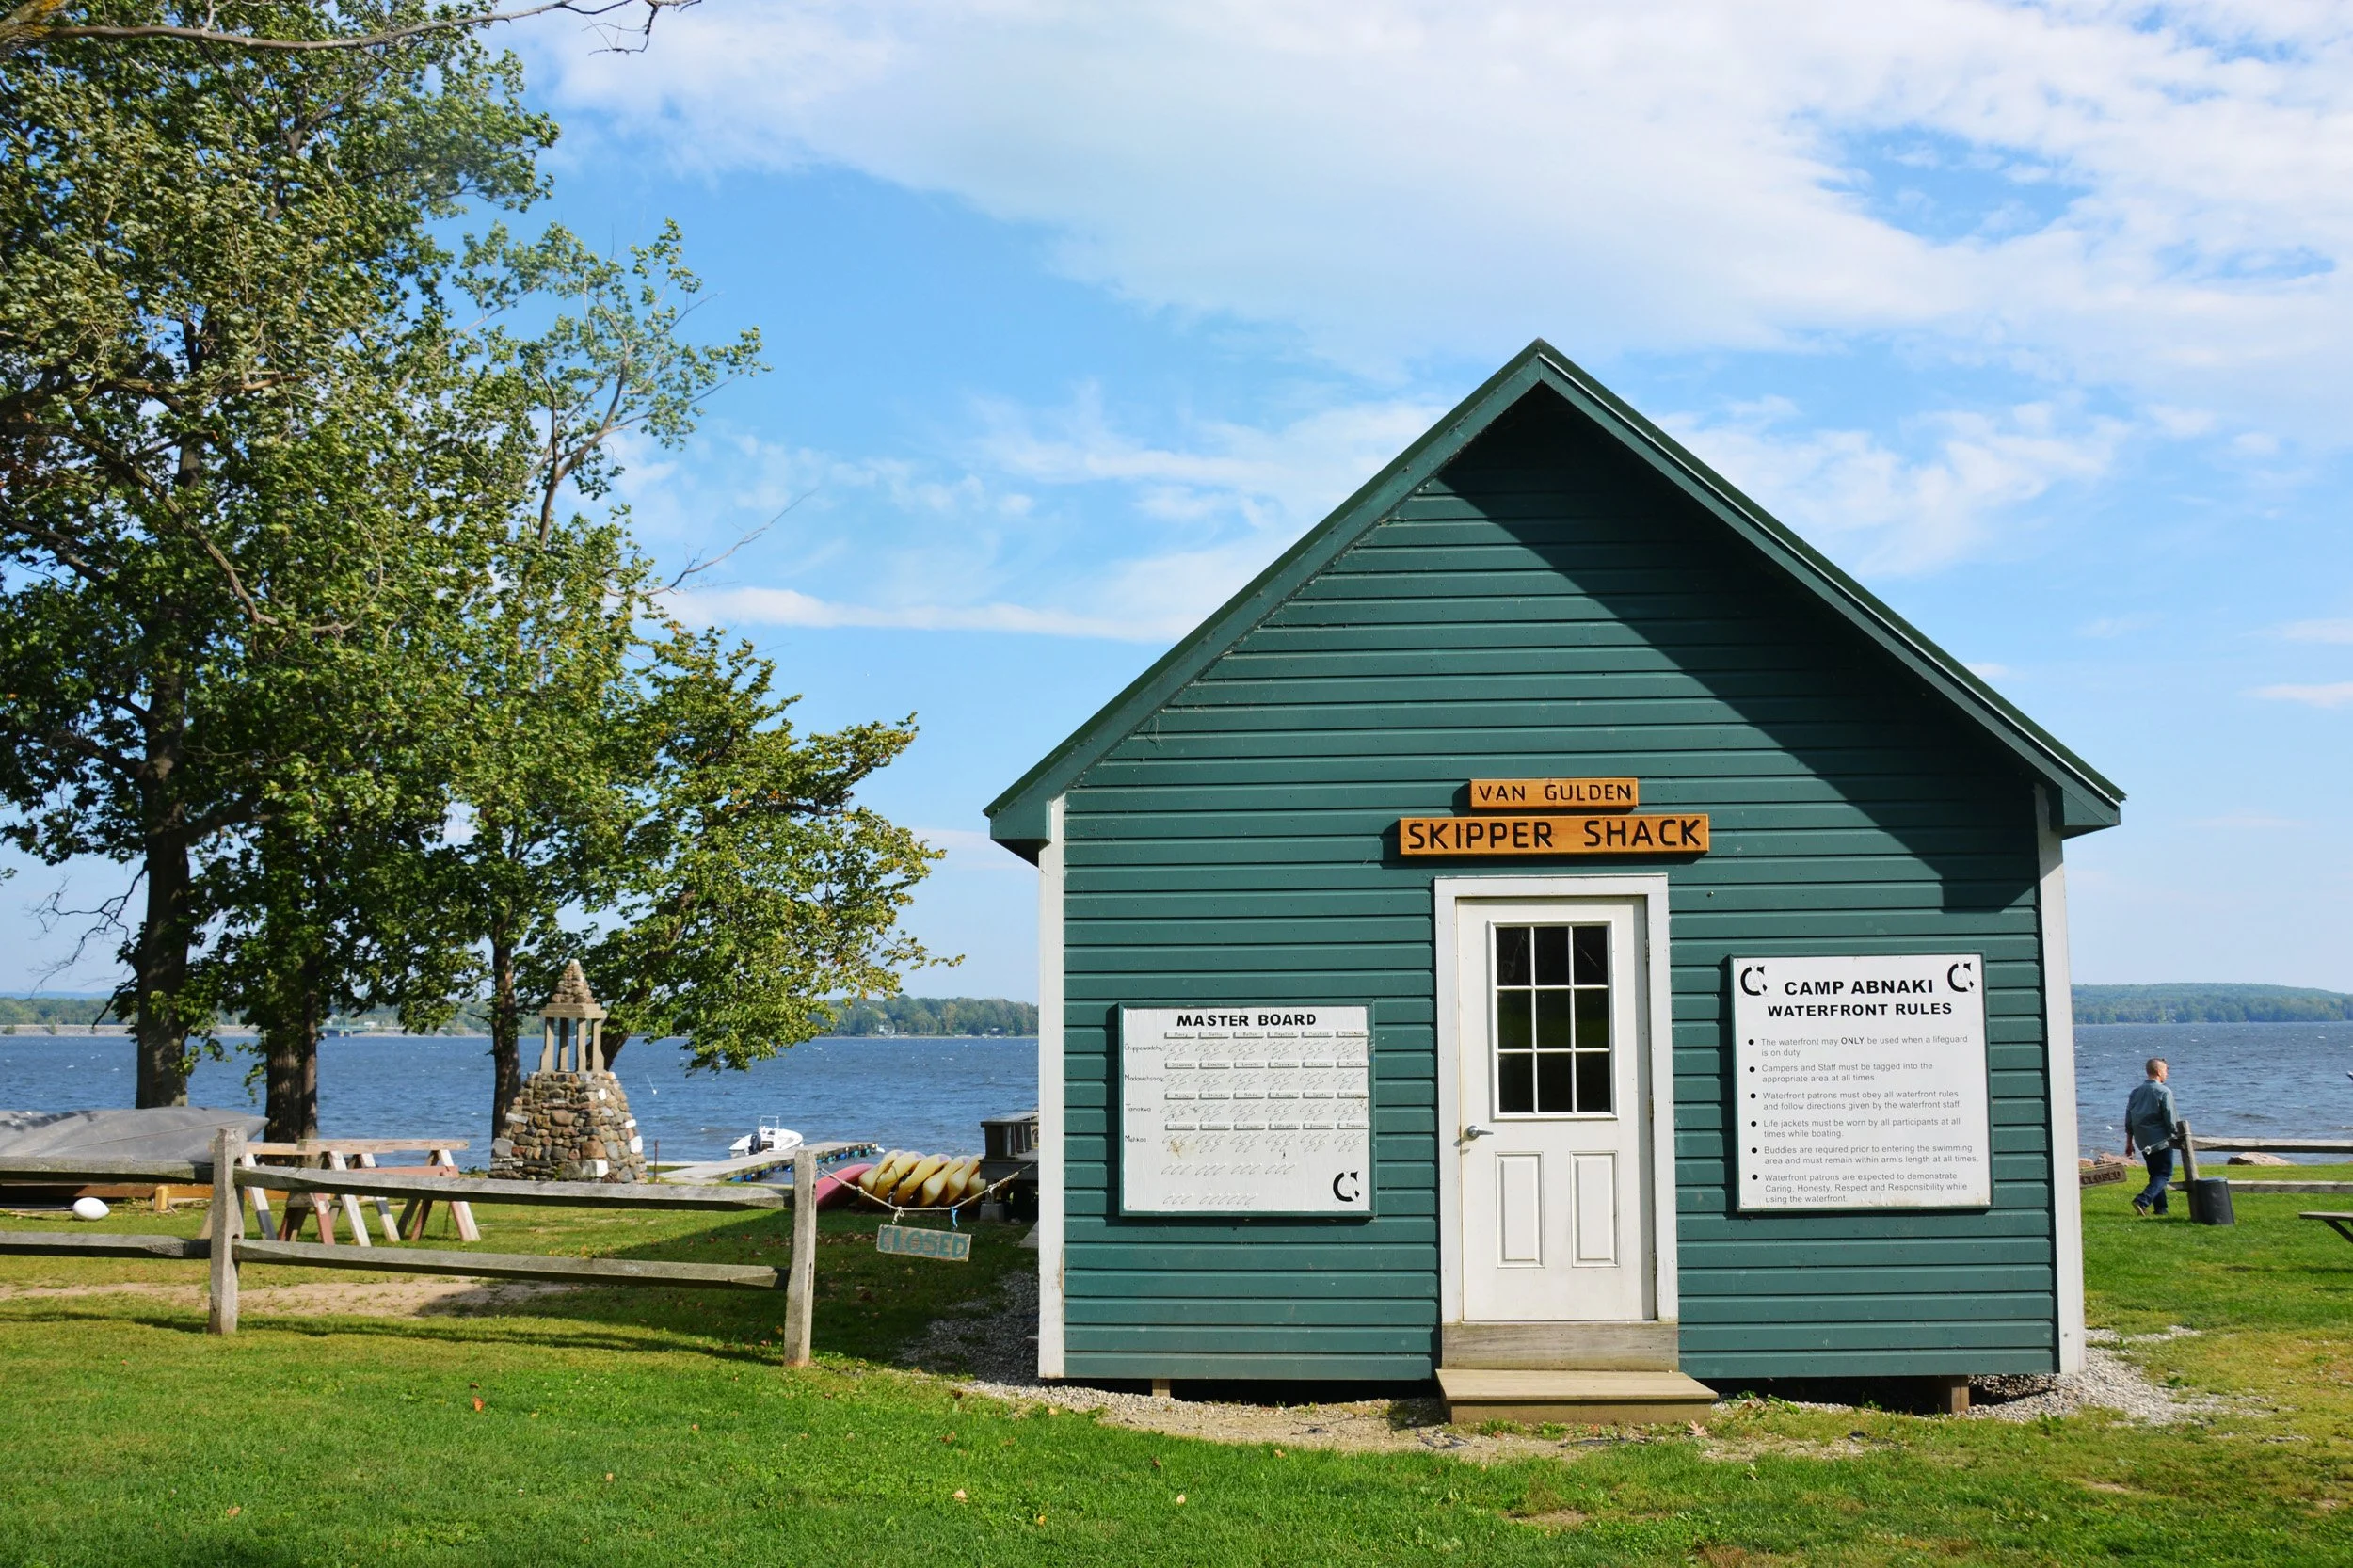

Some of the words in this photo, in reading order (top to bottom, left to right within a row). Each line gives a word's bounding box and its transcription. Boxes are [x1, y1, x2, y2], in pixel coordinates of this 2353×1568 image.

[1479, 785, 1525, 801] VAN
[1545, 784, 1632, 801] GULDEN
[1408, 822, 1553, 849] SKIPPER
[1583, 819, 1701, 847] SHACK
[1785, 981, 1844, 996] CAMP
[1850, 980, 1933, 994] ABNAKI
[1768, 1003, 1888, 1016] WATERFRONT
[1895, 1002, 1952, 1016] RULES
[1176, 1015, 1249, 1026] MASTER
[1258, 1014, 1317, 1026] BOARD
[1779, 1037, 1818, 1046] waterfront
[1933, 1036, 1967, 1045] lifeguard
[1784, 1048, 1800, 1057] duty
[1762, 1064, 1798, 1073] Campers
[1818, 1063, 1835, 1071] Staff
[1874, 1063, 1900, 1072] tagged
[1763, 1076, 1808, 1084] appropriate
[1842, 1073, 1850, 1081] all
[1763, 1091, 1804, 1099] Waterfront
[1808, 1092, 1837, 1100] patrons
[1862, 1091, 1881, 1099] obey
[1884, 1090, 1893, 1098] all
[1781, 1101, 1804, 1110] follow
[1807, 1101, 1846, 1110] directions
[1849, 1102, 1869, 1111] given
[1873, 1102, 1881, 1111] by
[1885, 1100, 1897, 1109] the
[1781, 1119, 1809, 1128] jackets
[1868, 1119, 1878, 1128] by
[1881, 1117, 1889, 1126] all
[1893, 1118, 1938, 1127] participants
[1765, 1145, 1797, 1154] Buddies
[1816, 1145, 1848, 1154] required
[1851, 1146, 1869, 1155] prior
[1882, 1146, 1914, 1155] entering
[1933, 1144, 1972, 1153] swimming
[1785, 1156, 1800, 1164] and
[1803, 1156, 1822, 1164] must
[1855, 1155, 1878, 1163] within
[1881, 1155, 1902, 1163] arm's
[1906, 1156, 1929, 1164] length
[1933, 1154, 1940, 1162] at
[1944, 1154, 1952, 1162] all
[1765, 1173, 1806, 1181] Waterfront
[1810, 1174, 1839, 1182] patrons
[1858, 1174, 1894, 1182] expected
[1907, 1172, 1957, 1180] demonstrate
[2080, 1170, 2121, 1185] CLOSED
[1835, 1184, 1867, 1192] Respect
[1888, 1183, 1944, 1192] Responsibility
[1766, 1194, 1786, 1203] using
[878, 1226, 968, 1259] CLOSED
